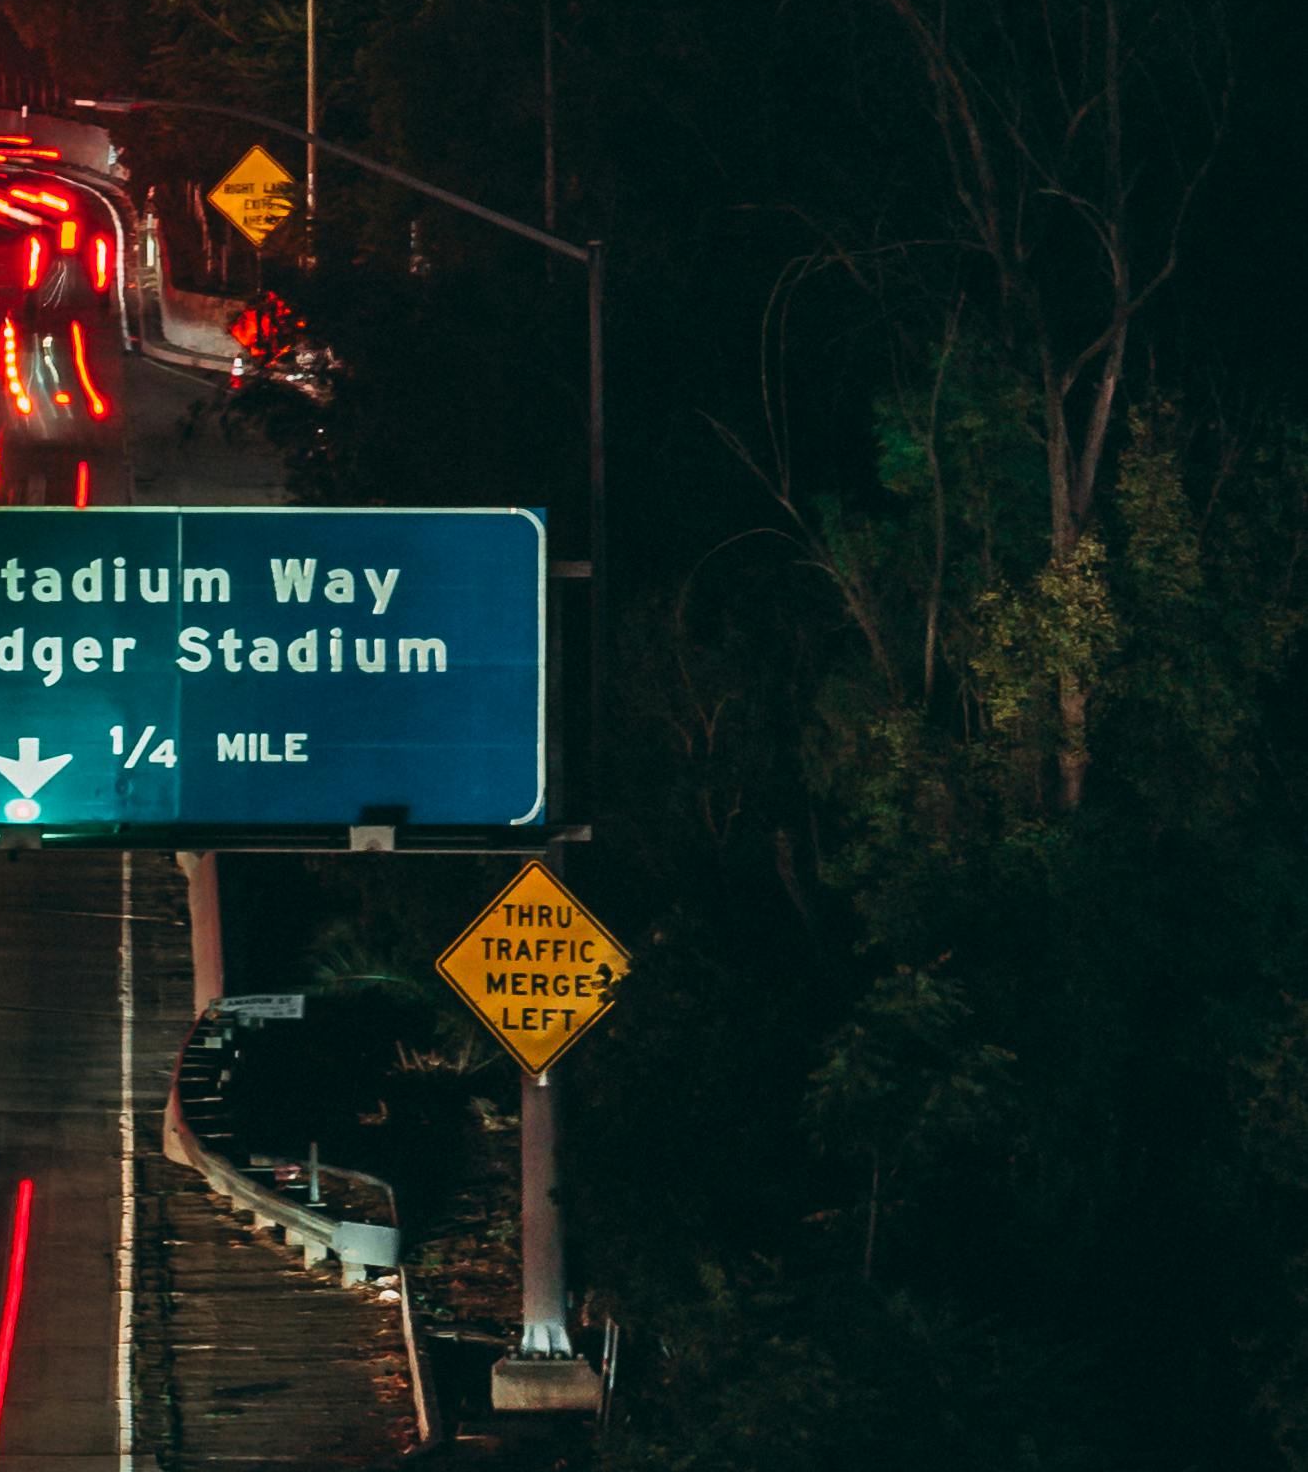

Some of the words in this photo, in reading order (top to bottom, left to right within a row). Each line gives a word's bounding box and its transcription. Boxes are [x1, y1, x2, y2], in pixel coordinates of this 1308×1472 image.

[270, 558, 401, 615] Way
[175, 626, 448, 673] Stadium
[217, 733, 308, 762] MILE
[503, 904, 572, 928] THRU
[482, 937, 595, 963] TRAFFIC
[486, 972, 592, 997] MERGE
[502, 1007, 576, 1032] LEFT
